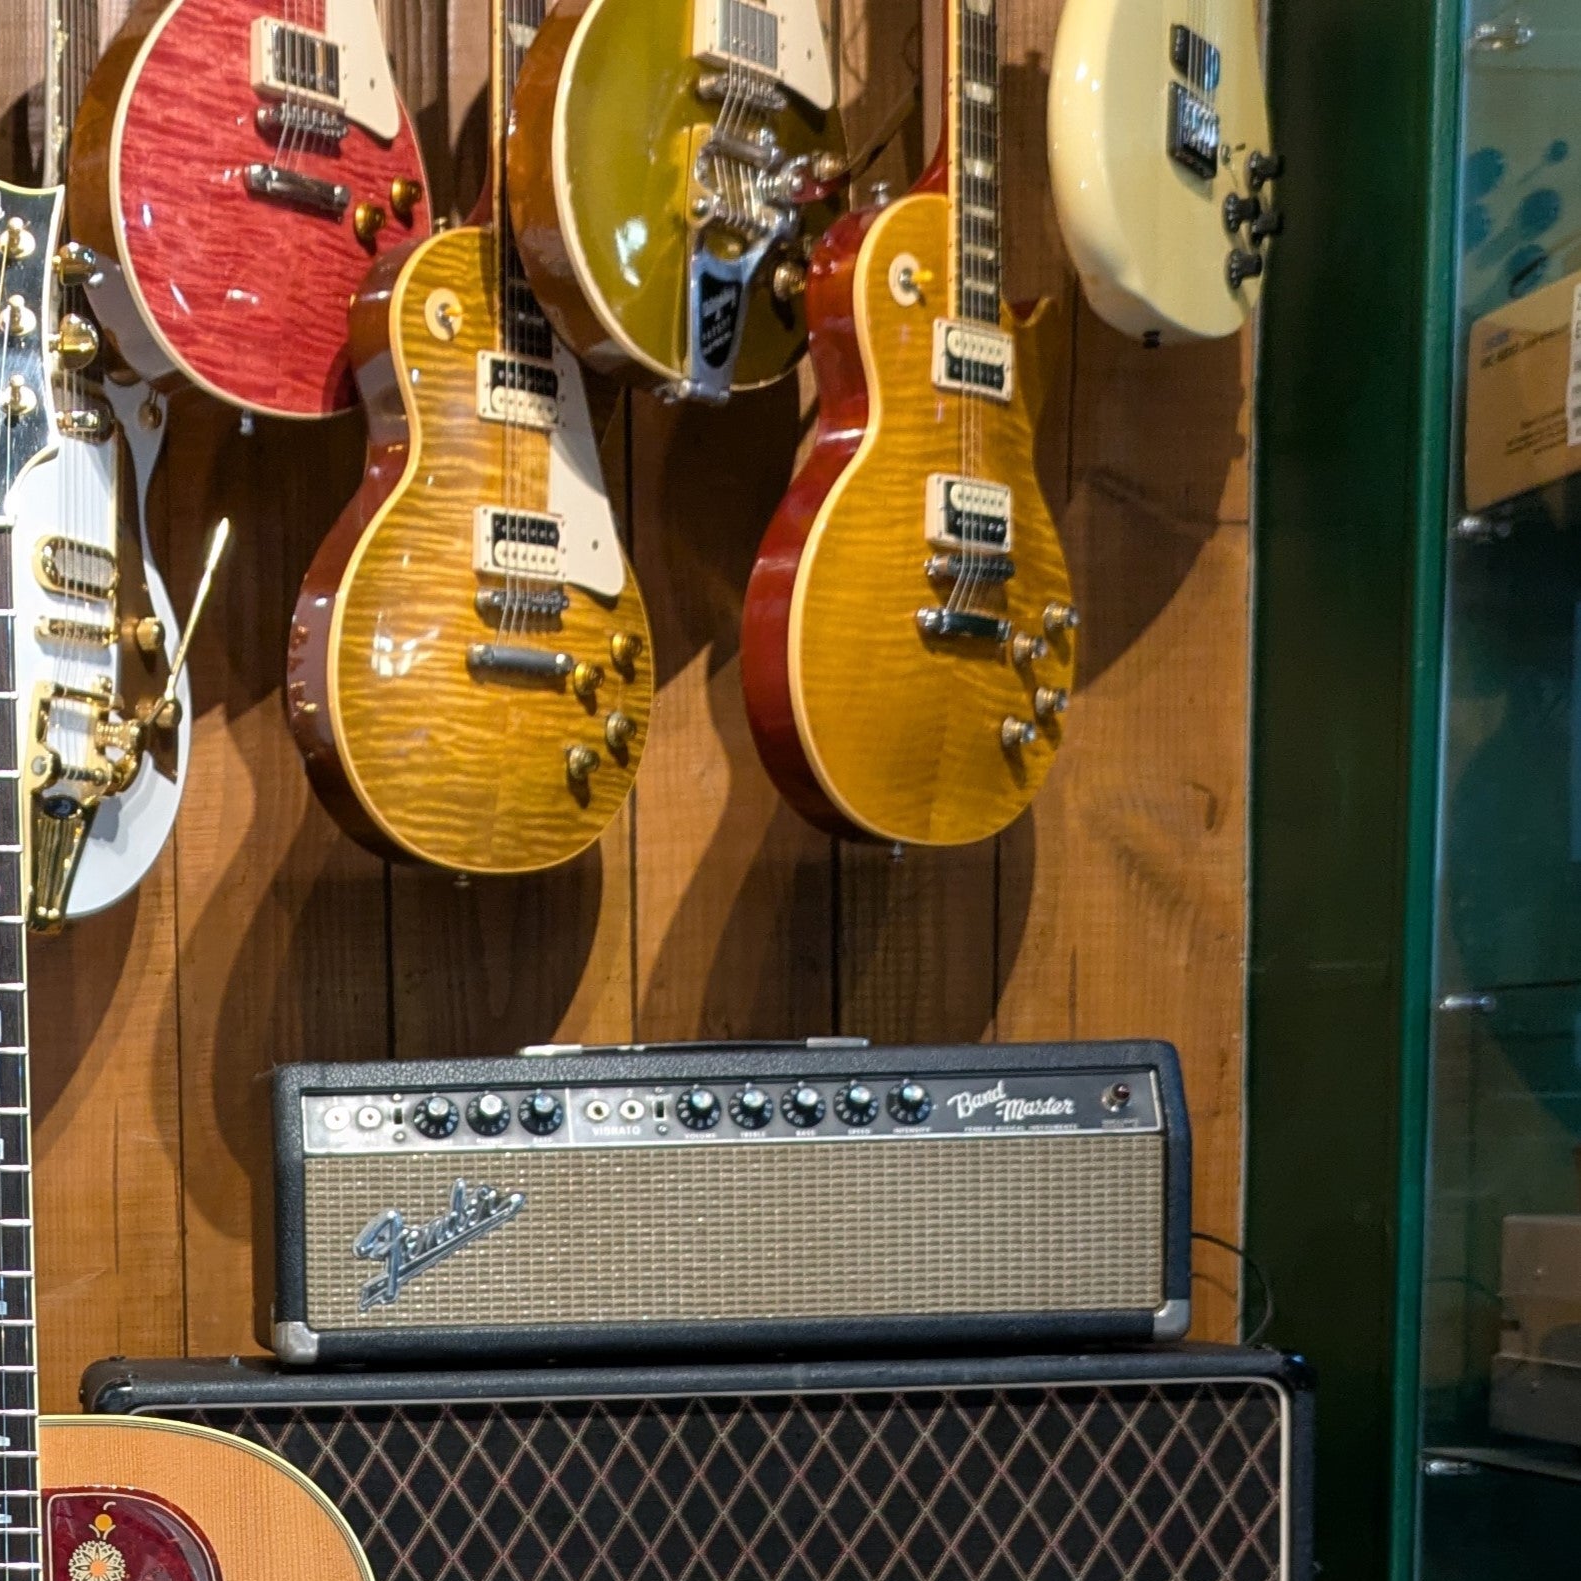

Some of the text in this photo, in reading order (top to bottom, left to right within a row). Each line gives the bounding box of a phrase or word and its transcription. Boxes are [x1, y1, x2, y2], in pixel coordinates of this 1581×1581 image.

[947, 1079, 1007, 1119] Band
[995, 1095, 1076, 1122] Master
[592, 1126, 641, 1136] VIBRATO
[684, 1132, 718, 1140] VOLUME
[353, 1178, 526, 1312] Fender
